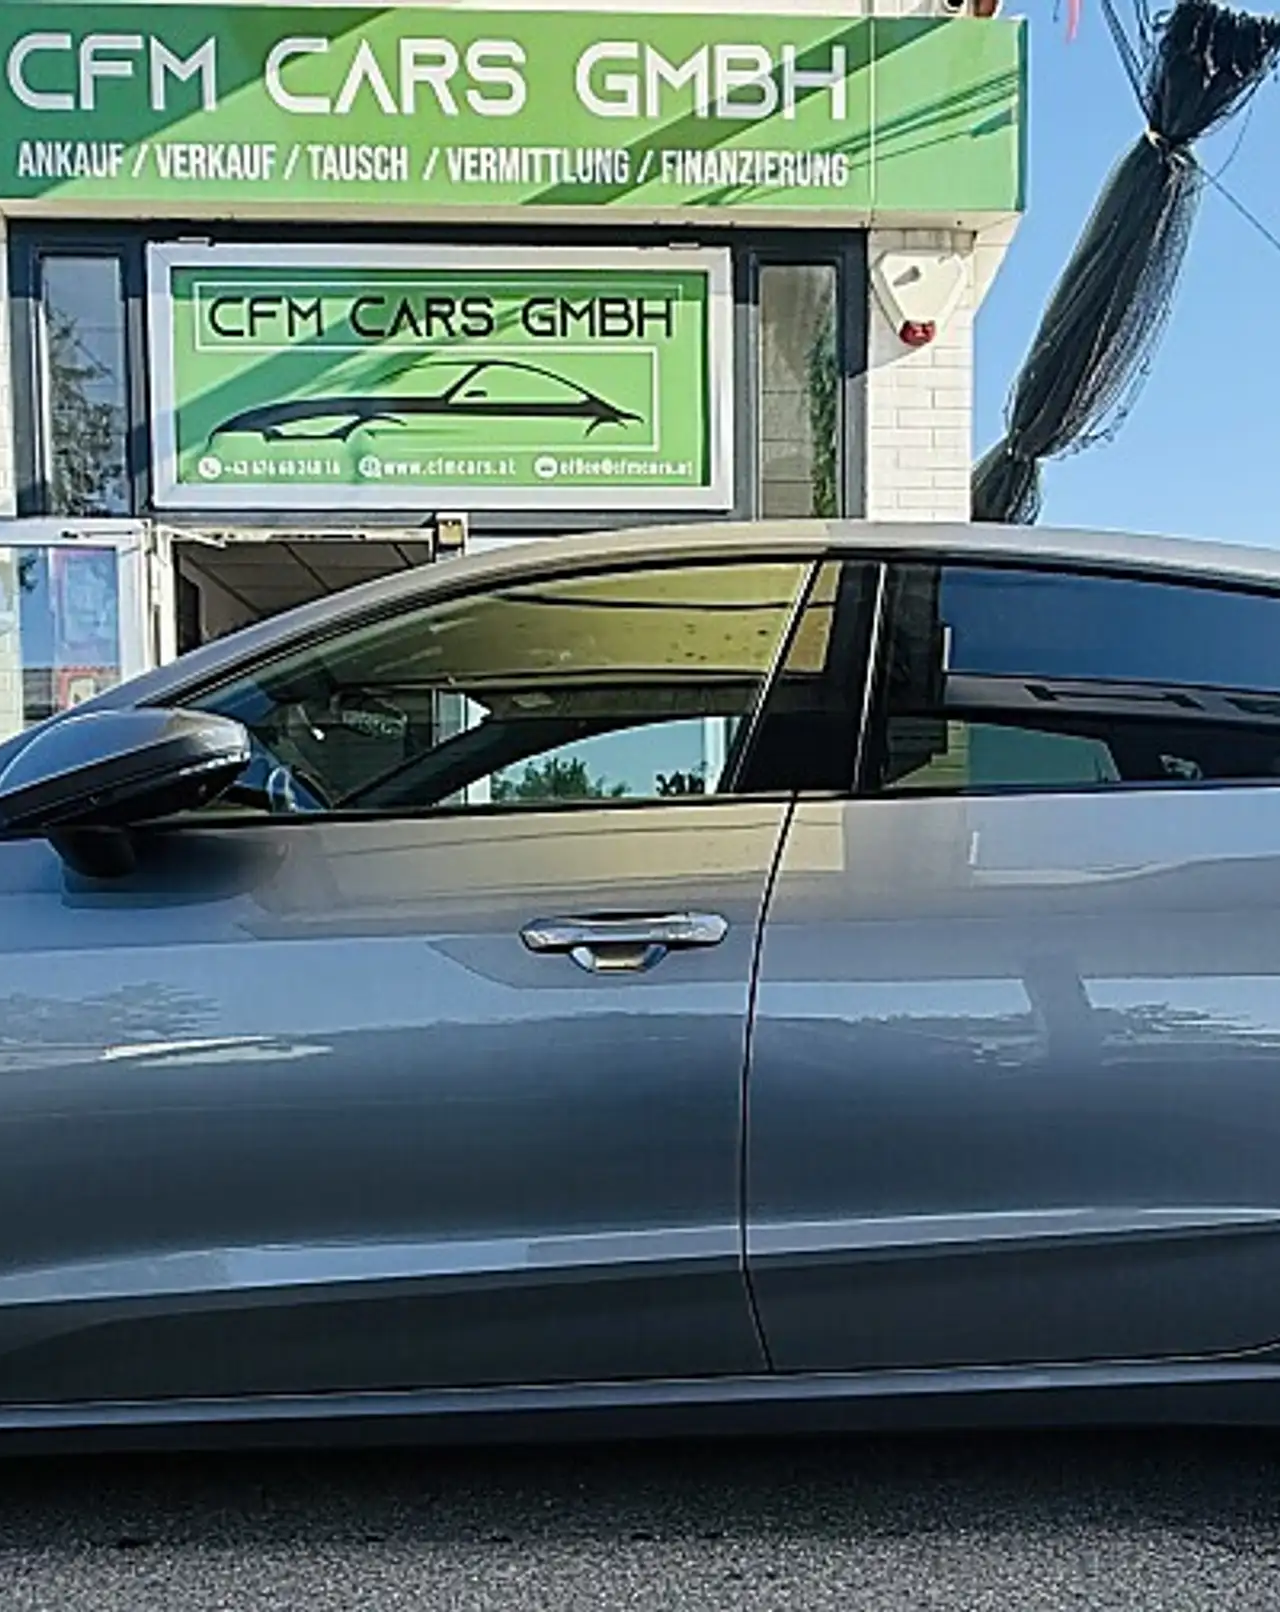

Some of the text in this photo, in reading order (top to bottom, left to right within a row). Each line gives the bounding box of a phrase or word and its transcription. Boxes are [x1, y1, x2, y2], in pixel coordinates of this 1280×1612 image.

[6, 32, 847, 121] CFM CARS GMBH
[17, 140, 126, 179] ANKAUF
[153, 142, 278, 181] VERKAUF
[306, 144, 409, 182] TAUSCH
[445, 146, 630, 185] VERMITTLUNG
[660, 150, 849, 188] FINANZIERUNG
[208, 296, 674, 339] CFM CARS GMBH
[383, 456, 517, 476] www.cfmcars.at
